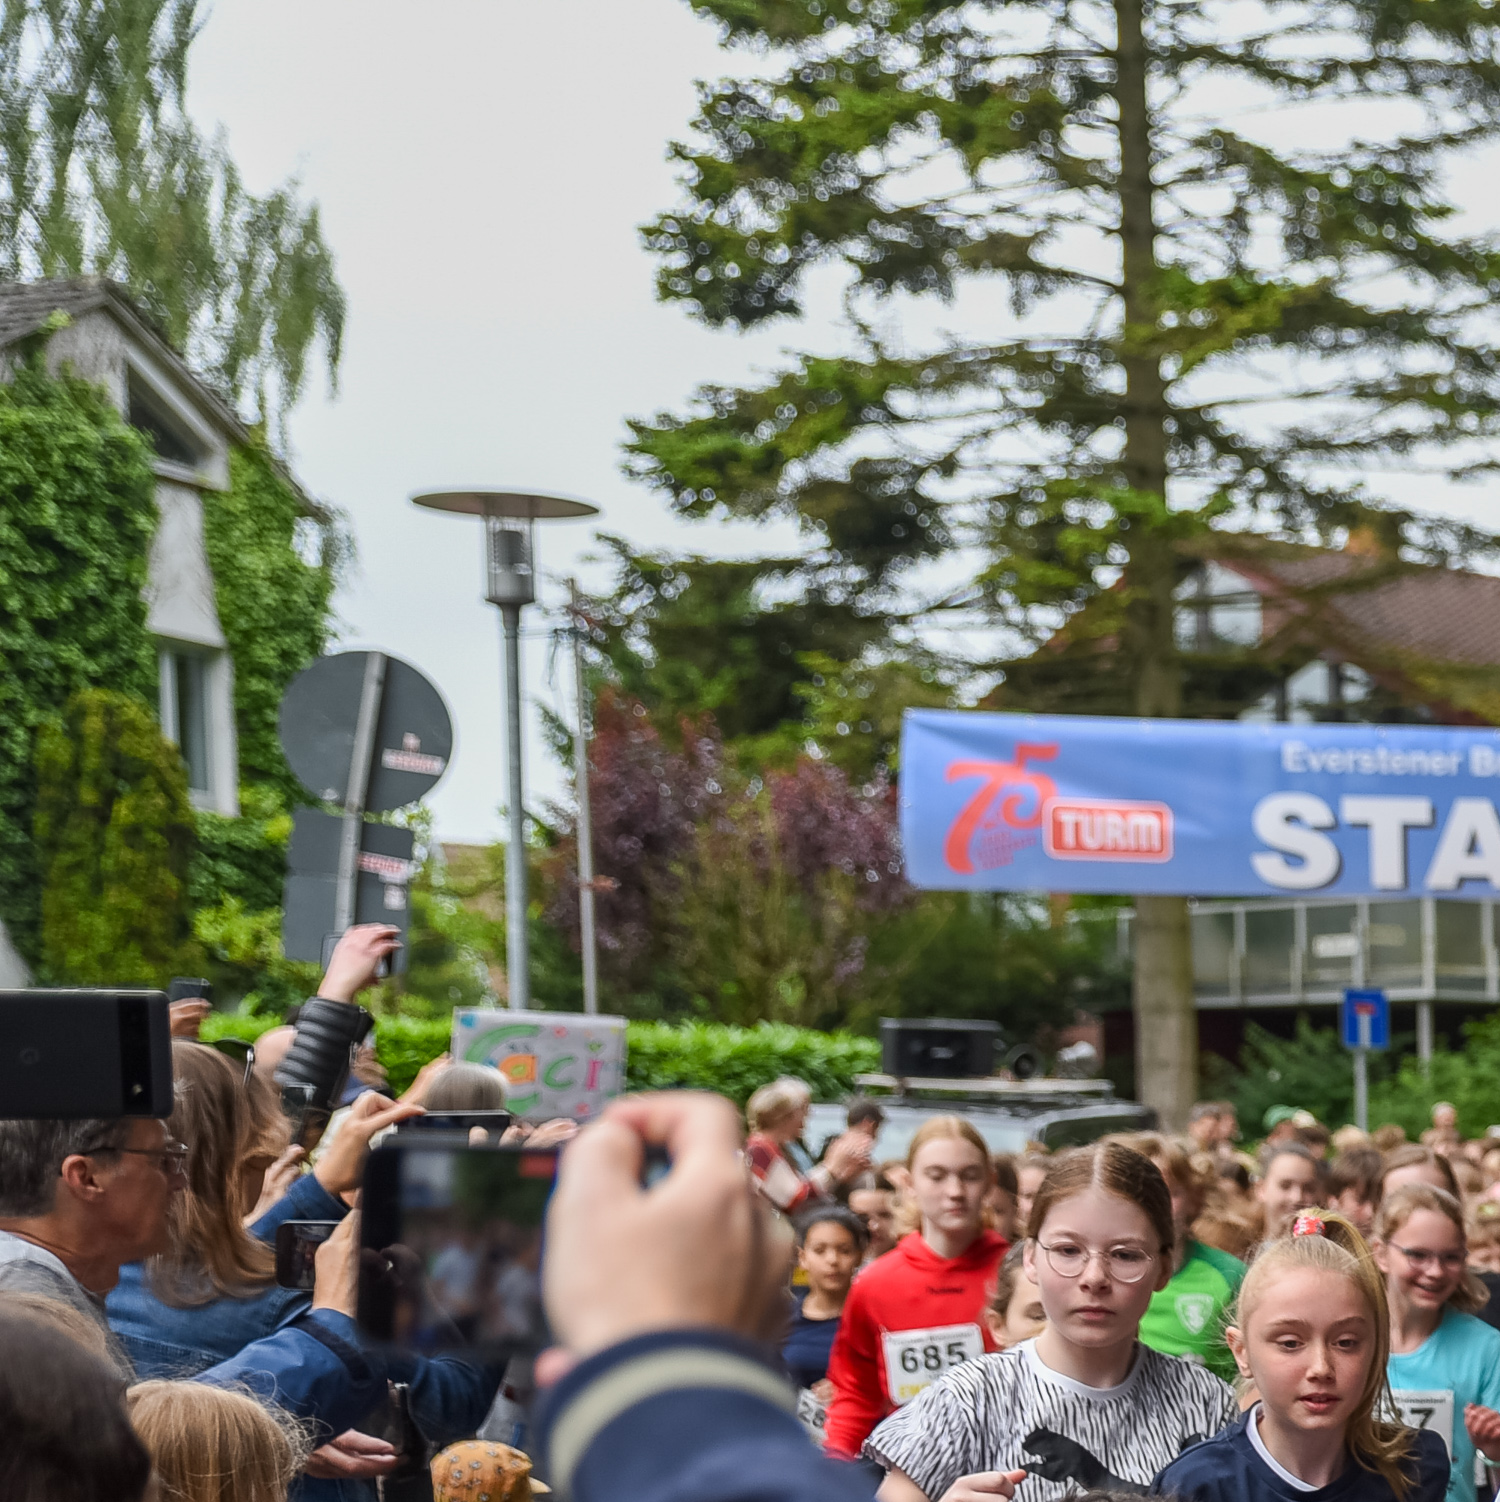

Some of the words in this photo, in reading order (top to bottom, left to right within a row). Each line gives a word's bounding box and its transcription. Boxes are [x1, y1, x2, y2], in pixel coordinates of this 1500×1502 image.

[1281, 741, 1461, 776] Everstener
[1056, 810, 1164, 851] TURM
[901, 1341, 967, 1374] 685
